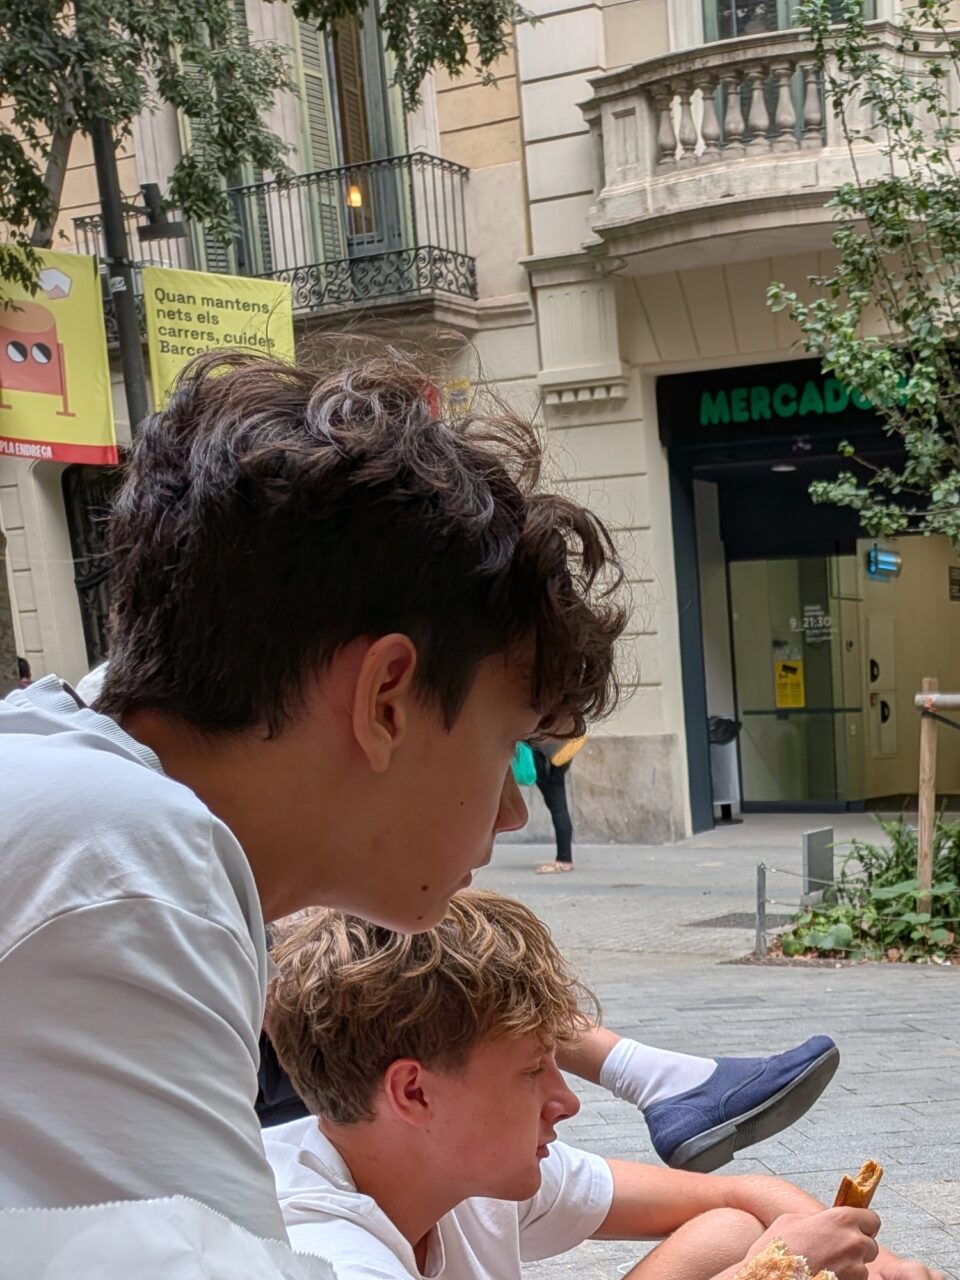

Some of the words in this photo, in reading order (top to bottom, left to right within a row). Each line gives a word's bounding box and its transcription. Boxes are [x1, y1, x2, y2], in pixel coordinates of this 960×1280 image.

[154, 287, 196, 305] Quan
[201, 296, 270, 314] mantens
[156, 308, 192, 322] nets
[197, 311, 220, 325] els
[158, 325, 220, 344] carrers,
[224, 332, 275, 348] cuides
[159, 340, 208, 357] Barce
